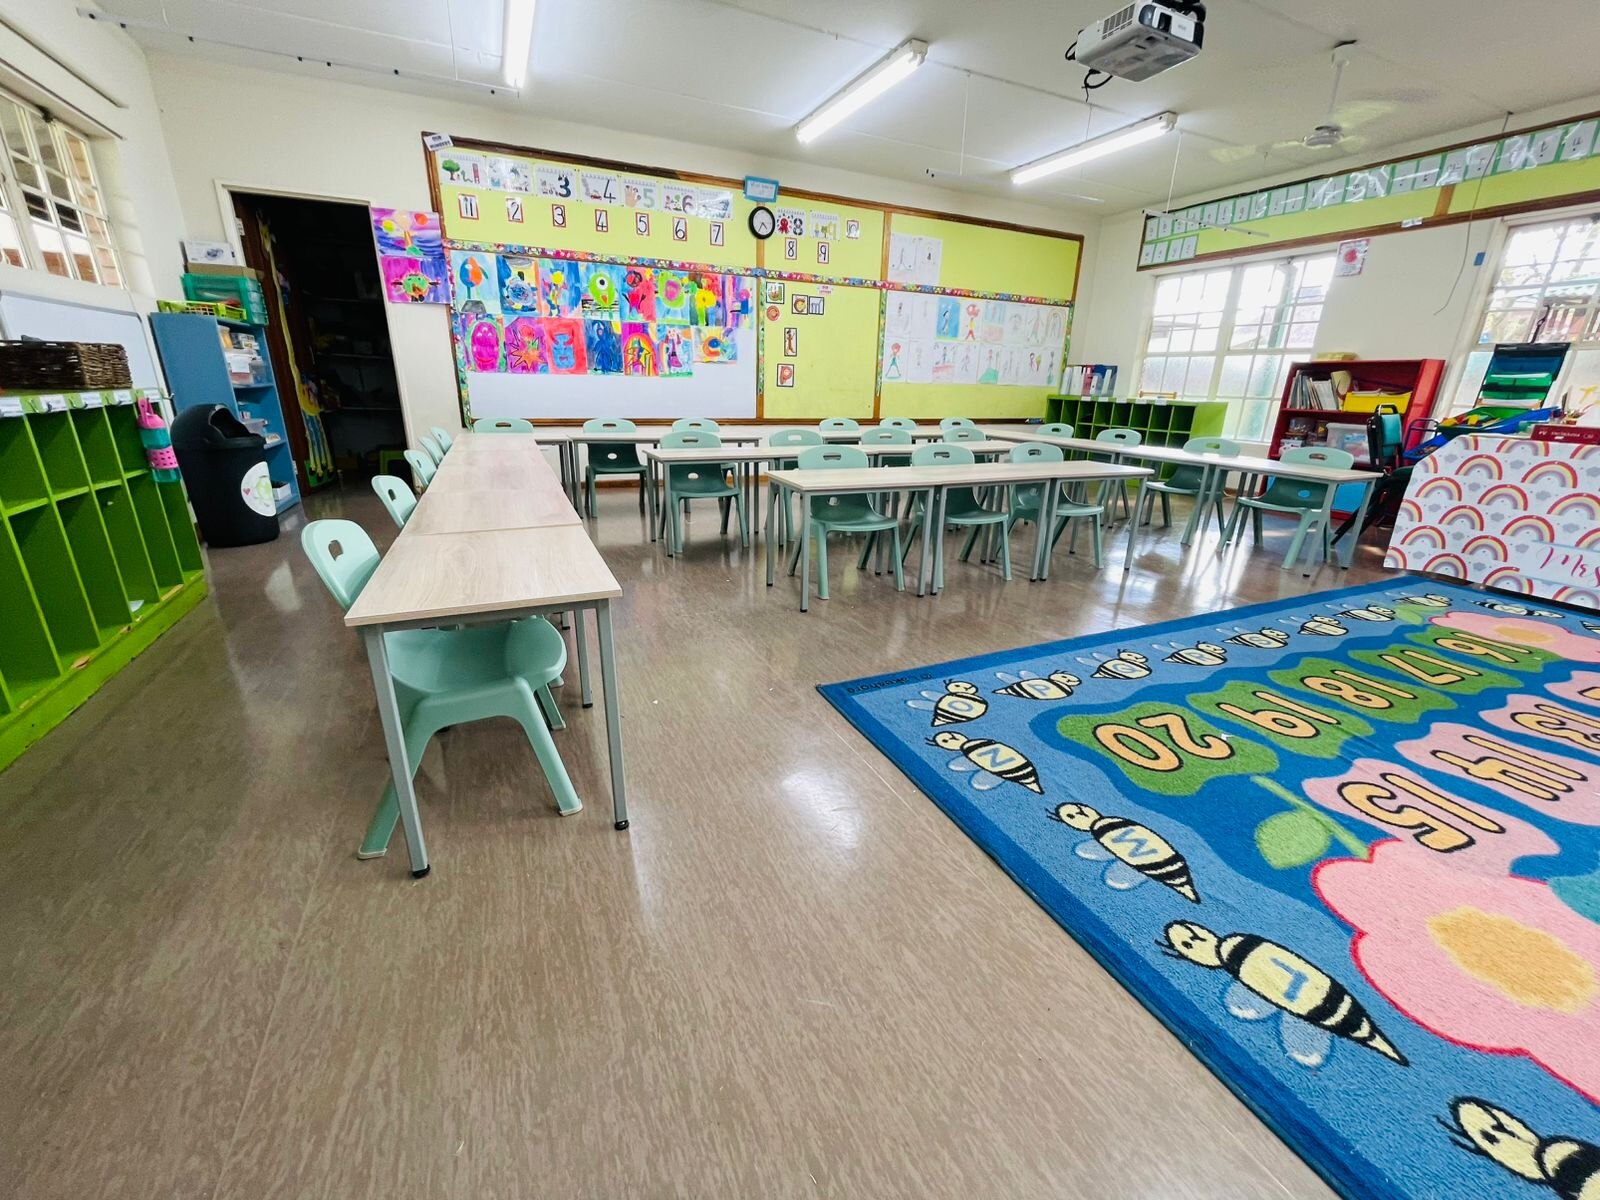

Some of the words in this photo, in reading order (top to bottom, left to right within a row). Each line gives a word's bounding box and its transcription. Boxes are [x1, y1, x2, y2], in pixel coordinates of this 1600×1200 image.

[556, 176, 571, 198] 3
[604, 180, 616, 203] 4
[643, 188, 655, 208] 5
[511, 202, 521, 221] 2
[554, 207, 565, 226] 3
[597, 212, 607, 231] 4
[638, 216, 648, 233] 5
[675, 220, 685, 240] 6
[712, 224, 721, 243] 7
[787, 241, 795, 257] 8
[820, 245, 828, 261] 9
[1248, 635, 1272, 646] S
[1433, 631, 1532, 663] 16
[1378, 649, 1483, 685] 17
[1034, 683, 1053, 696] P
[1300, 669, 1418, 709] 18
[949, 700, 973, 712] O
[1216, 690, 1340, 739] 19
[1092, 712, 1236, 772] 20
[977, 746, 1016, 768] N
[1430, 734, 1589, 801] 14
[1337, 772, 1507, 853] 15
[1111, 827, 1159, 859] M
[1270, 957, 1309, 1002] L
